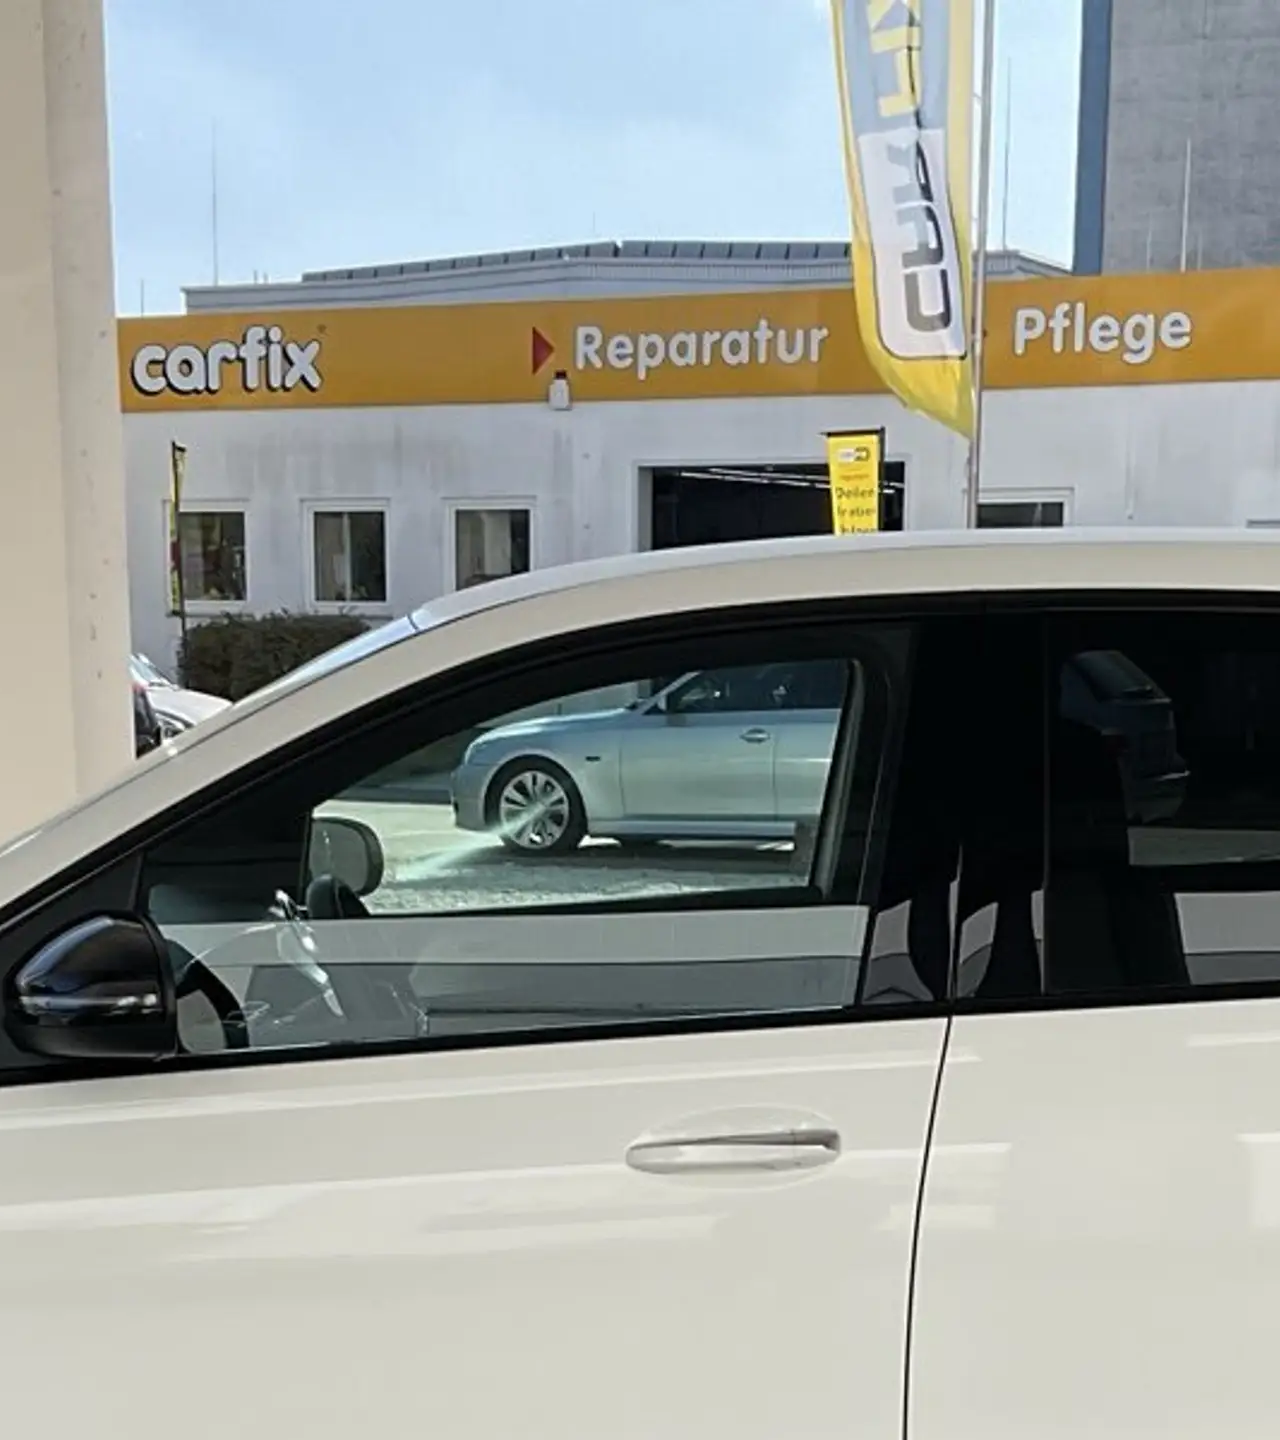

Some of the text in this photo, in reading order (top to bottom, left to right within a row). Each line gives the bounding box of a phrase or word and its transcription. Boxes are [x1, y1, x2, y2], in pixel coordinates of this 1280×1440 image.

[131, 325, 323, 396] carfix
[574, 318, 829, 381] Reparatur
[1014, 301, 1192, 365] Pflege
